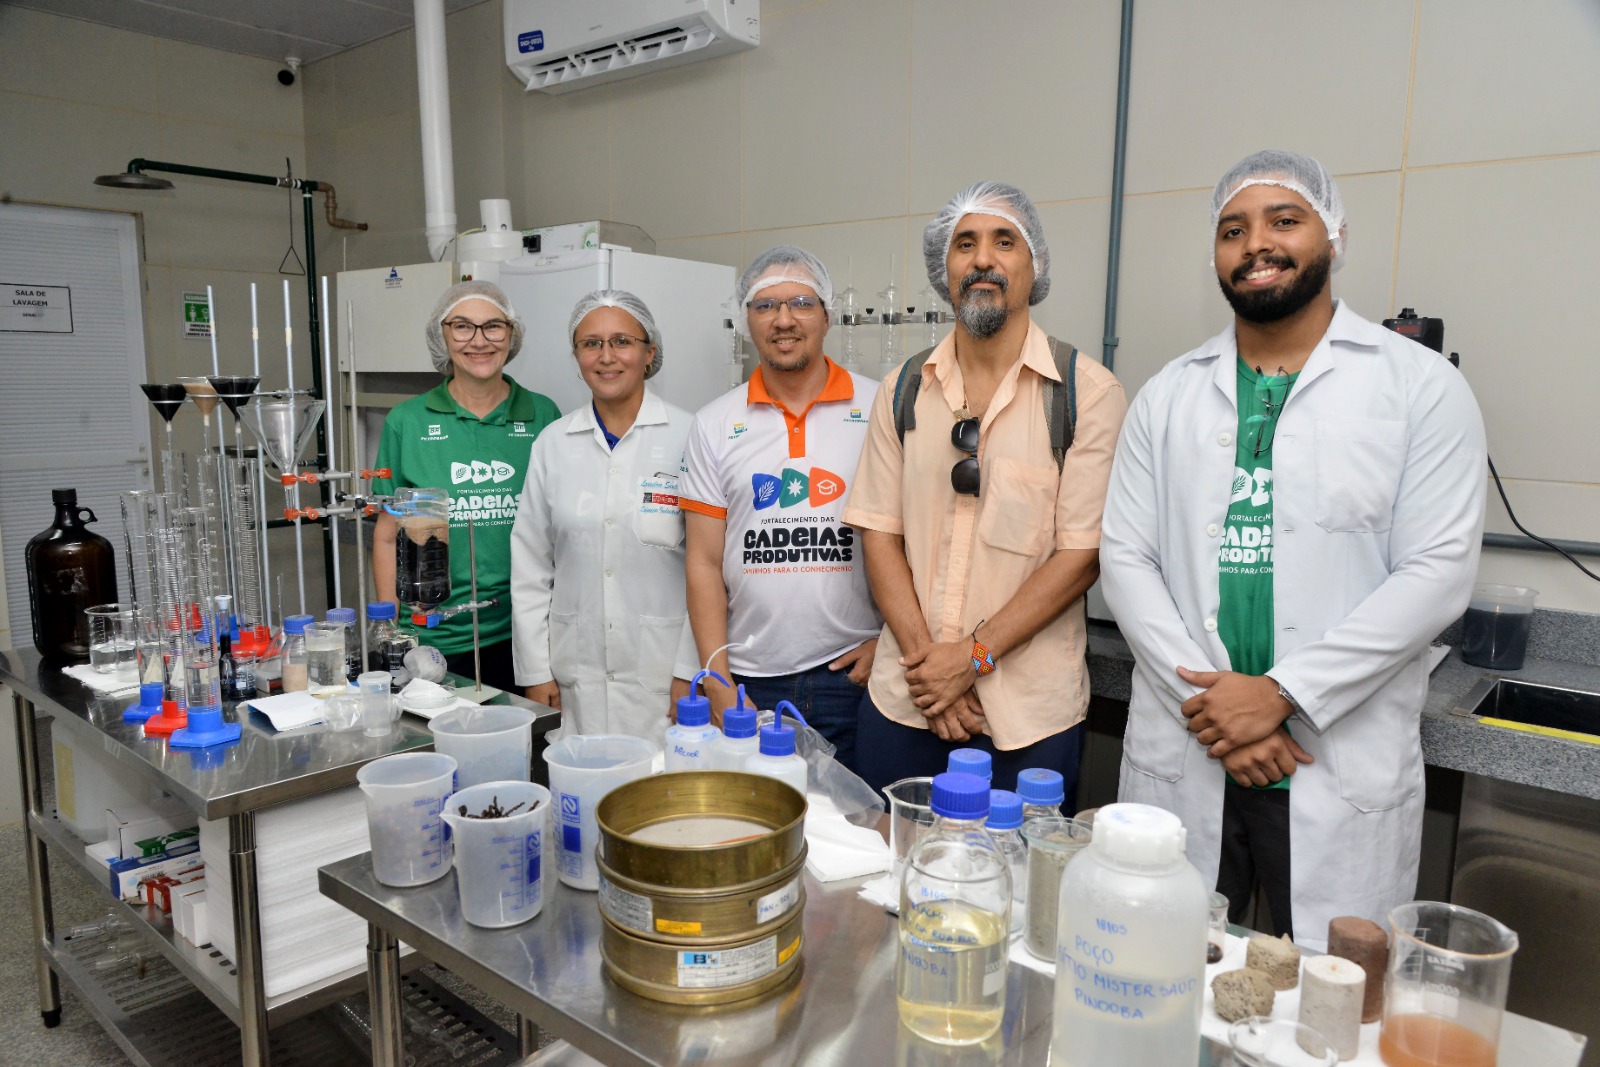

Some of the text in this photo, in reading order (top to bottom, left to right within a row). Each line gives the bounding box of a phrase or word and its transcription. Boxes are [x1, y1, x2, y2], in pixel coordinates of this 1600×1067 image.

[761, 516, 818, 525] FORTALECIMENTO
[743, 548, 853, 564] PRODUTIVAS
[801, 565, 853, 573] CONHECIMENTO
[1075, 935, 1114, 966] POÇO
[1094, 974, 1155, 998] MISTER
